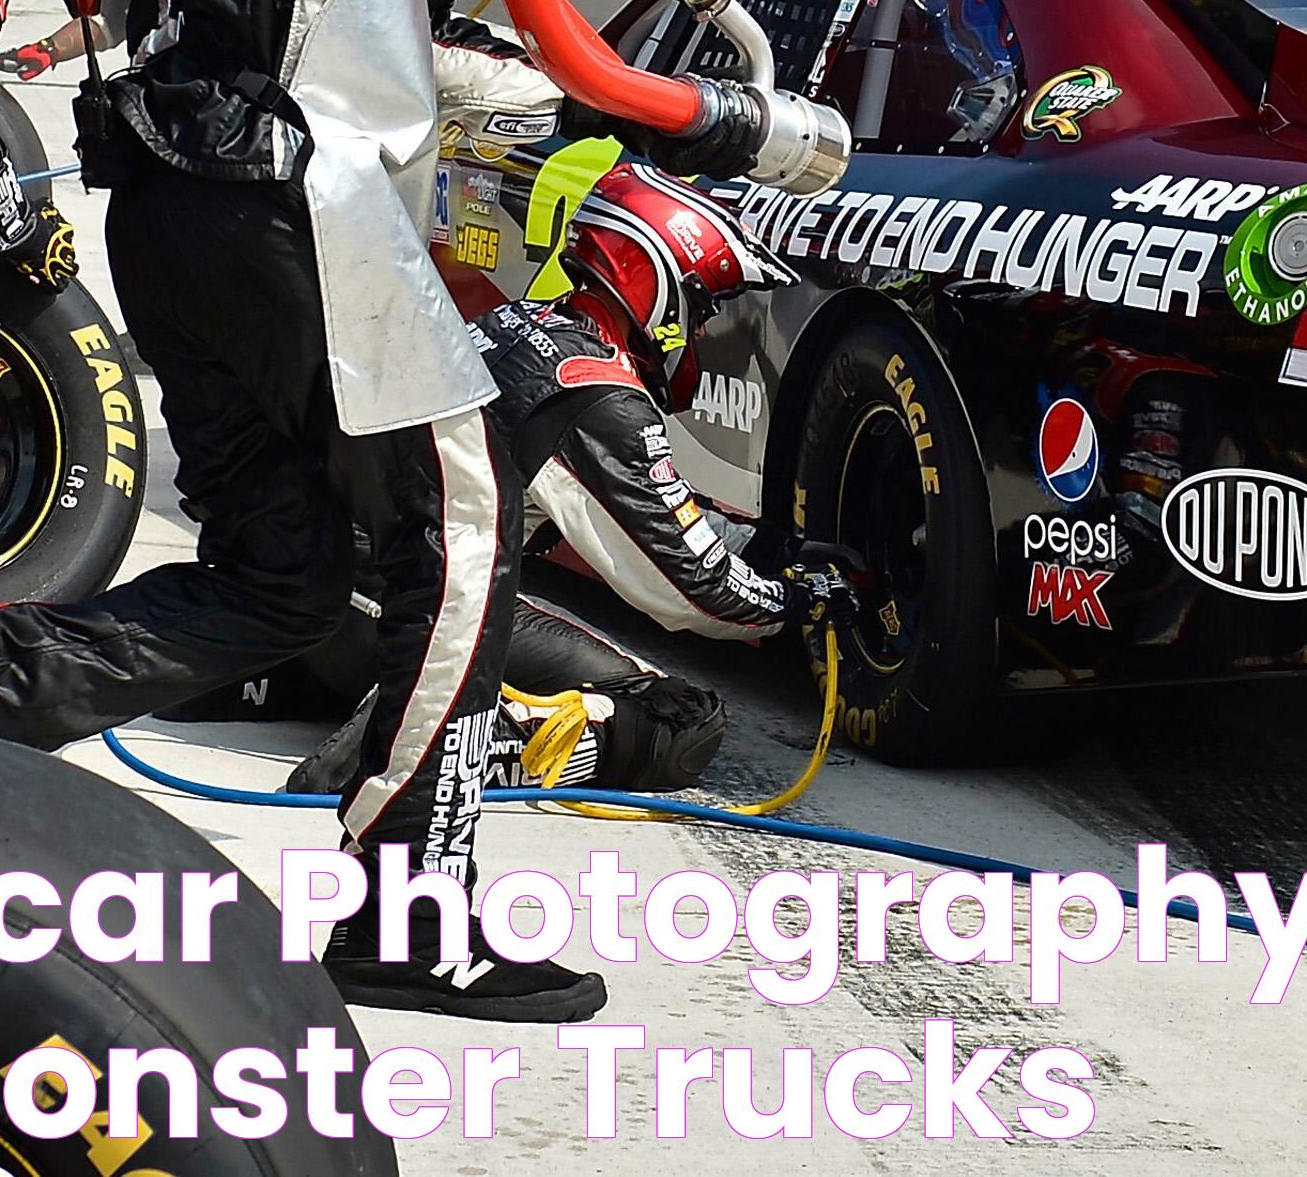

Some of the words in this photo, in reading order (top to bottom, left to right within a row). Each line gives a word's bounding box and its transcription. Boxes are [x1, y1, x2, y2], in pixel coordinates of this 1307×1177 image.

[1048, 96, 1099, 110] STATE
[1049, 81, 1119, 101] QUAKER
[466, 201, 491, 216] POLE
[1111, 174, 1270, 222] AARP
[457, 223, 500, 272] JEGS
[820, 193, 892, 264] TO
[869, 196, 983, 274] END
[964, 205, 1217, 317] HUNGER
[653, 322, 687, 353] 24
[69, 323, 137, 499] EAGLE
[693, 370, 763, 433] AARP
[884, 353, 941, 495] EAGLE
[1024, 514, 1117, 565] pepsi
[1027, 561, 1116, 631] MAX
[444, 722, 462, 752] TO
[435, 753, 459, 804] END
